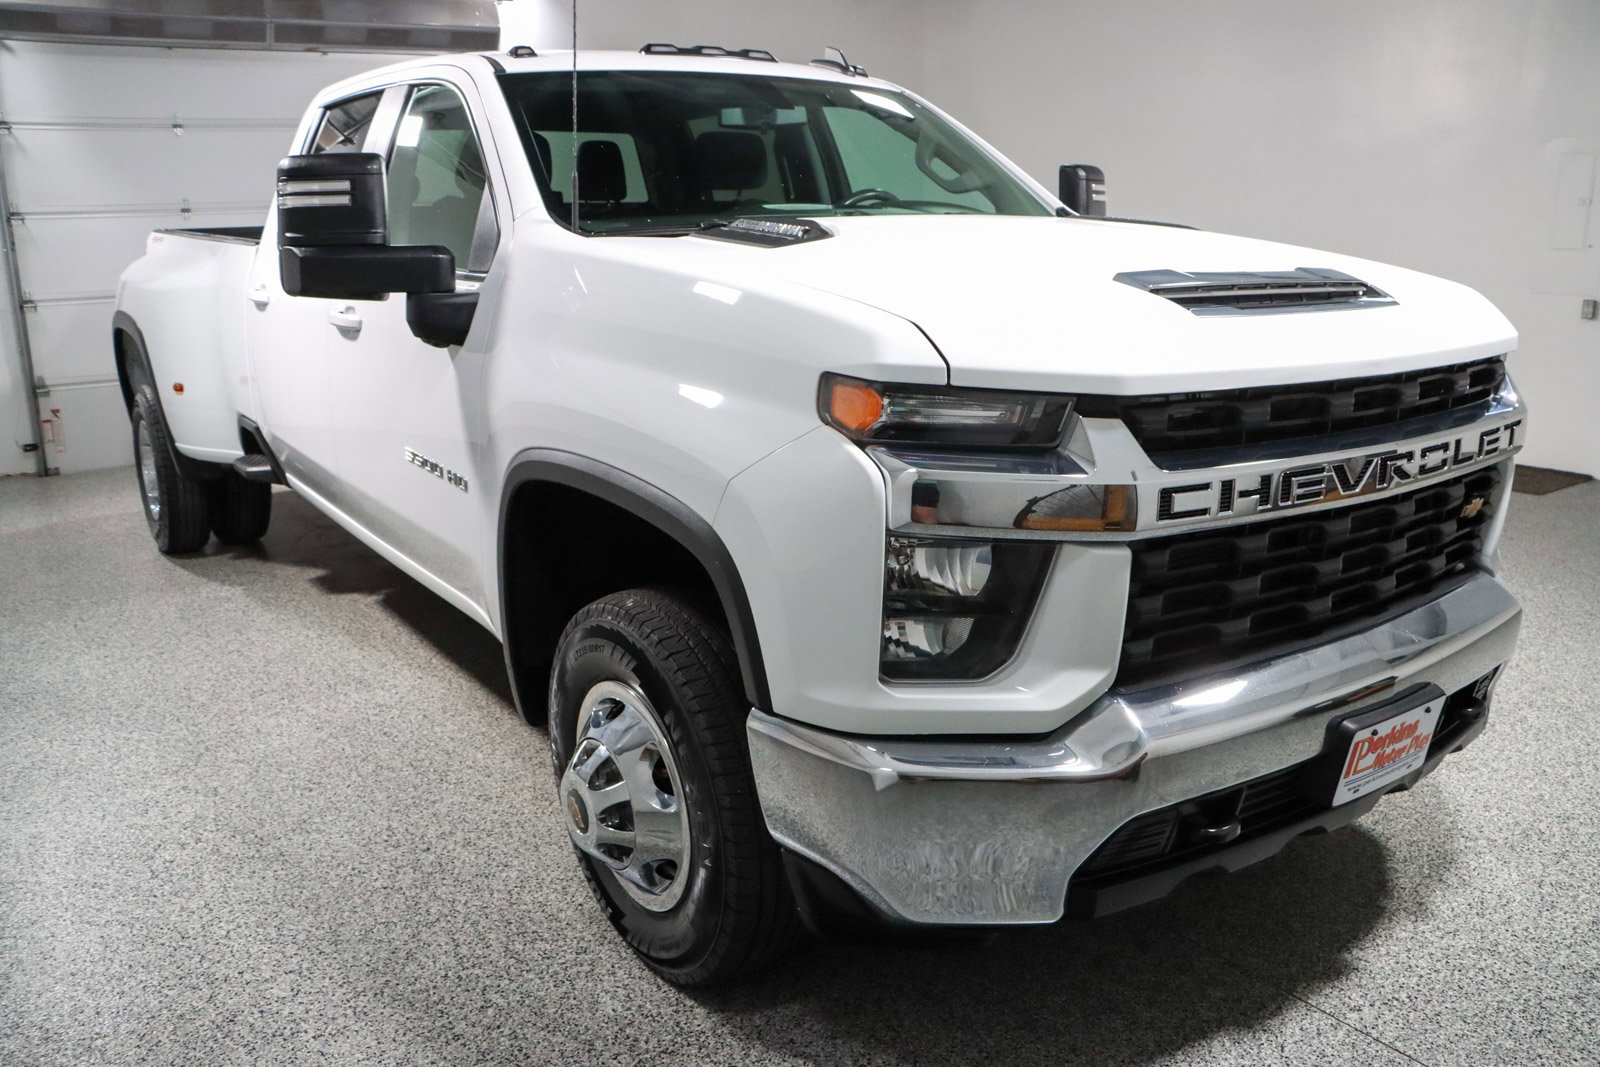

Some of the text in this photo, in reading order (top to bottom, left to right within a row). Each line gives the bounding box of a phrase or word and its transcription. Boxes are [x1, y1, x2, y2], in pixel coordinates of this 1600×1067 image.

[404, 446, 469, 493] 3500 HD
[1156, 420, 1522, 521] CHEVROLET
[1344, 719, 1421, 777] Perkins
[1373, 744, 1408, 770] Motor
